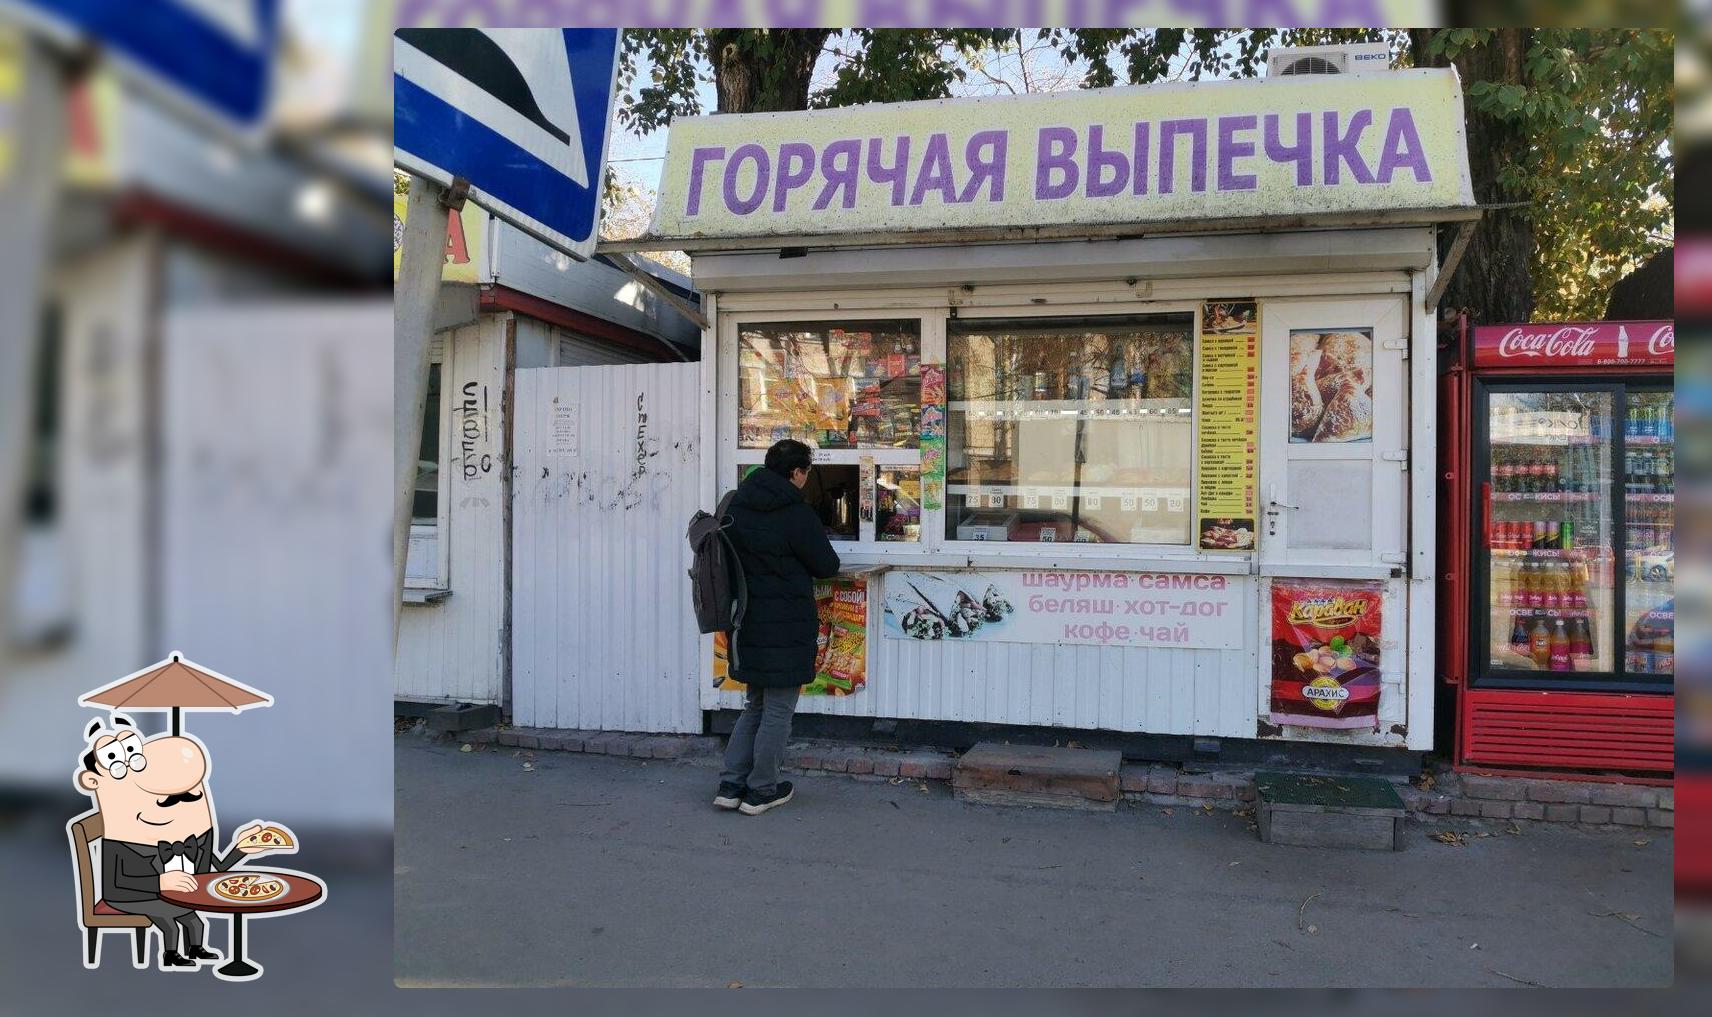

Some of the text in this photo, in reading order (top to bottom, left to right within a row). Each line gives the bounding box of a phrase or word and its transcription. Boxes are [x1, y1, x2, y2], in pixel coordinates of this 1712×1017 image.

[1354, 53, 1386, 61] BEKO
[685, 107, 1433, 217] ГОРЯЧАЯ ВЫПЕЧКА
[1498, 326, 1600, 358] Coca-Cola
[1022, 572, 1227, 592] шаурма самса
[1028, 594, 1229, 617] беляш хот-дог
[1064, 620, 1190, 643] кофе чай
[1306, 686, 1346, 698] АРАХИС
